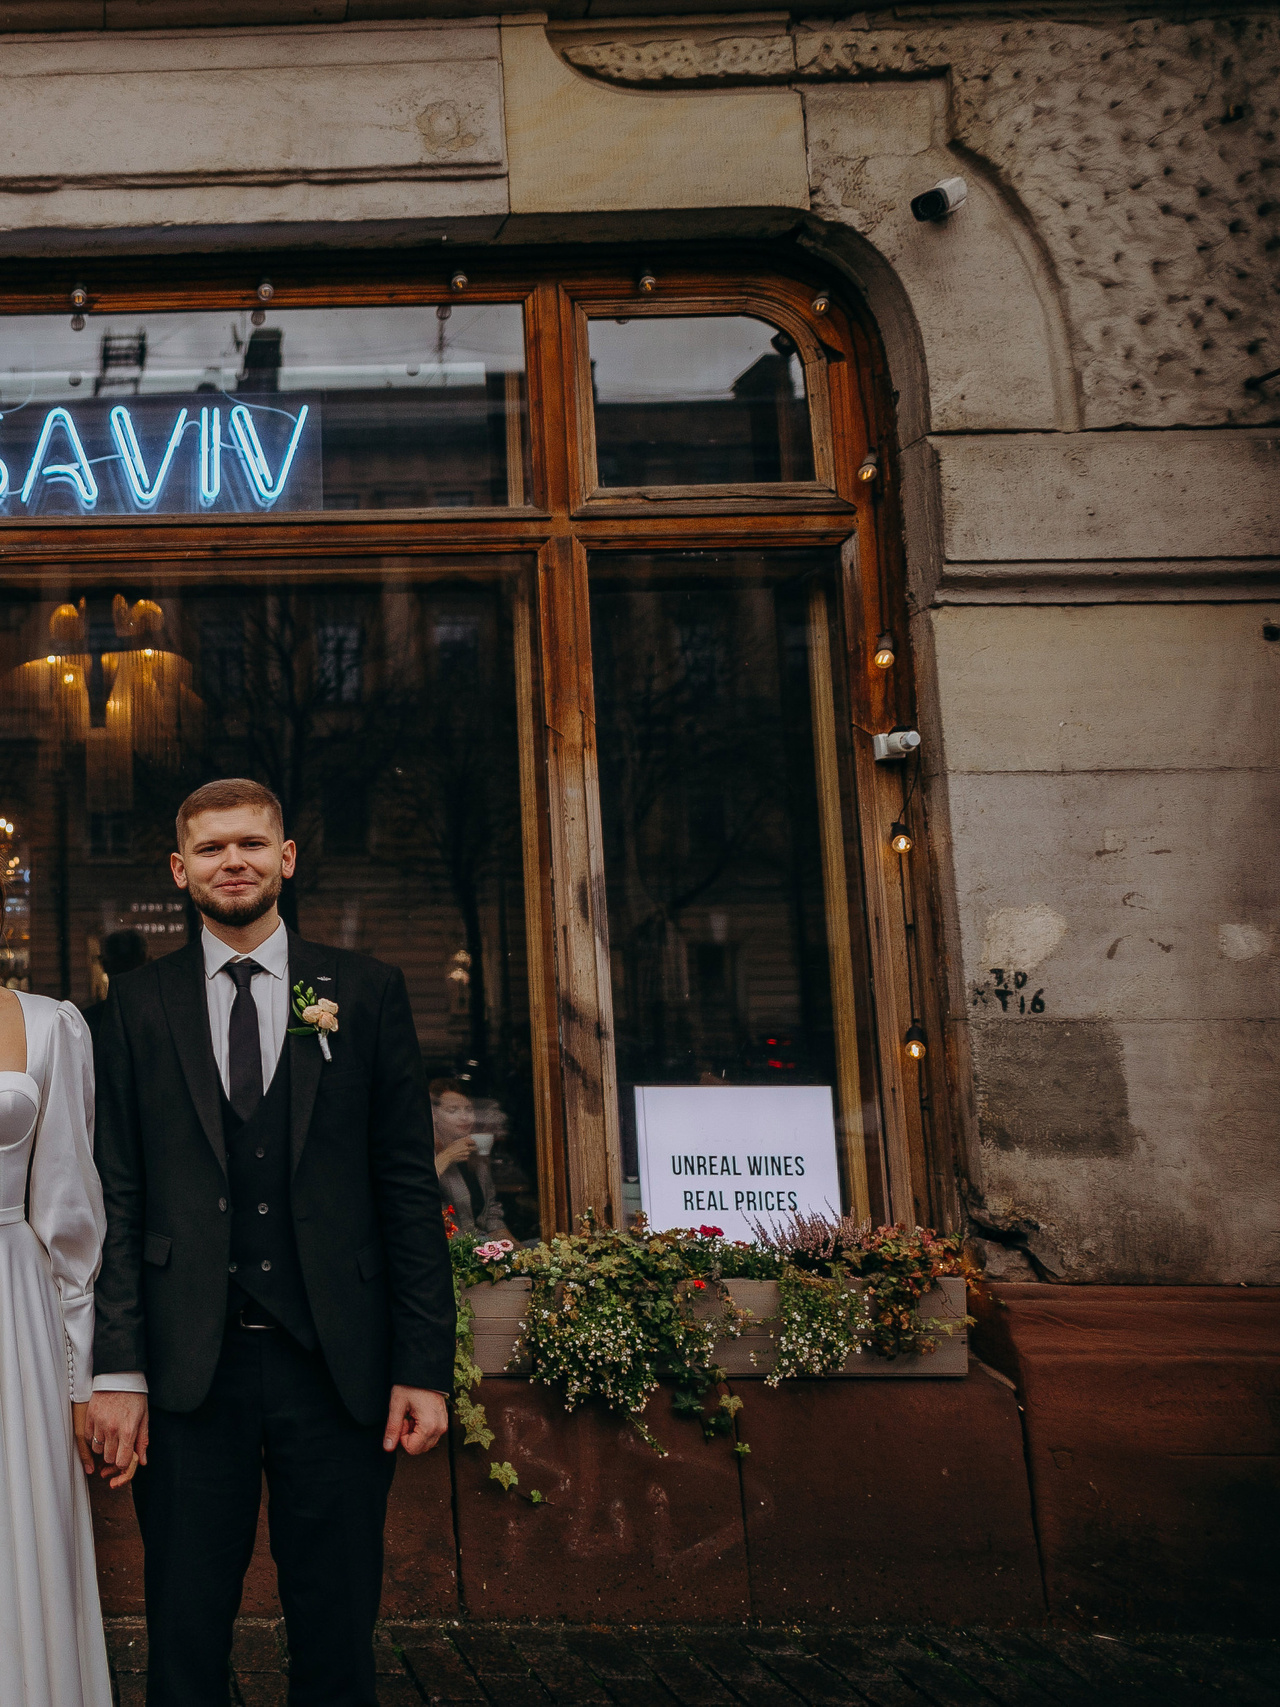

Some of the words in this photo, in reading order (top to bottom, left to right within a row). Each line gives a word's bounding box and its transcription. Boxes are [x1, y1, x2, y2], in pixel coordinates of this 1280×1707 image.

[671, 1155, 742, 1176] UNREAL
[747, 1155, 805, 1176] WINES
[683, 1190, 729, 1211] REAL
[734, 1190, 798, 1211] PRICES
